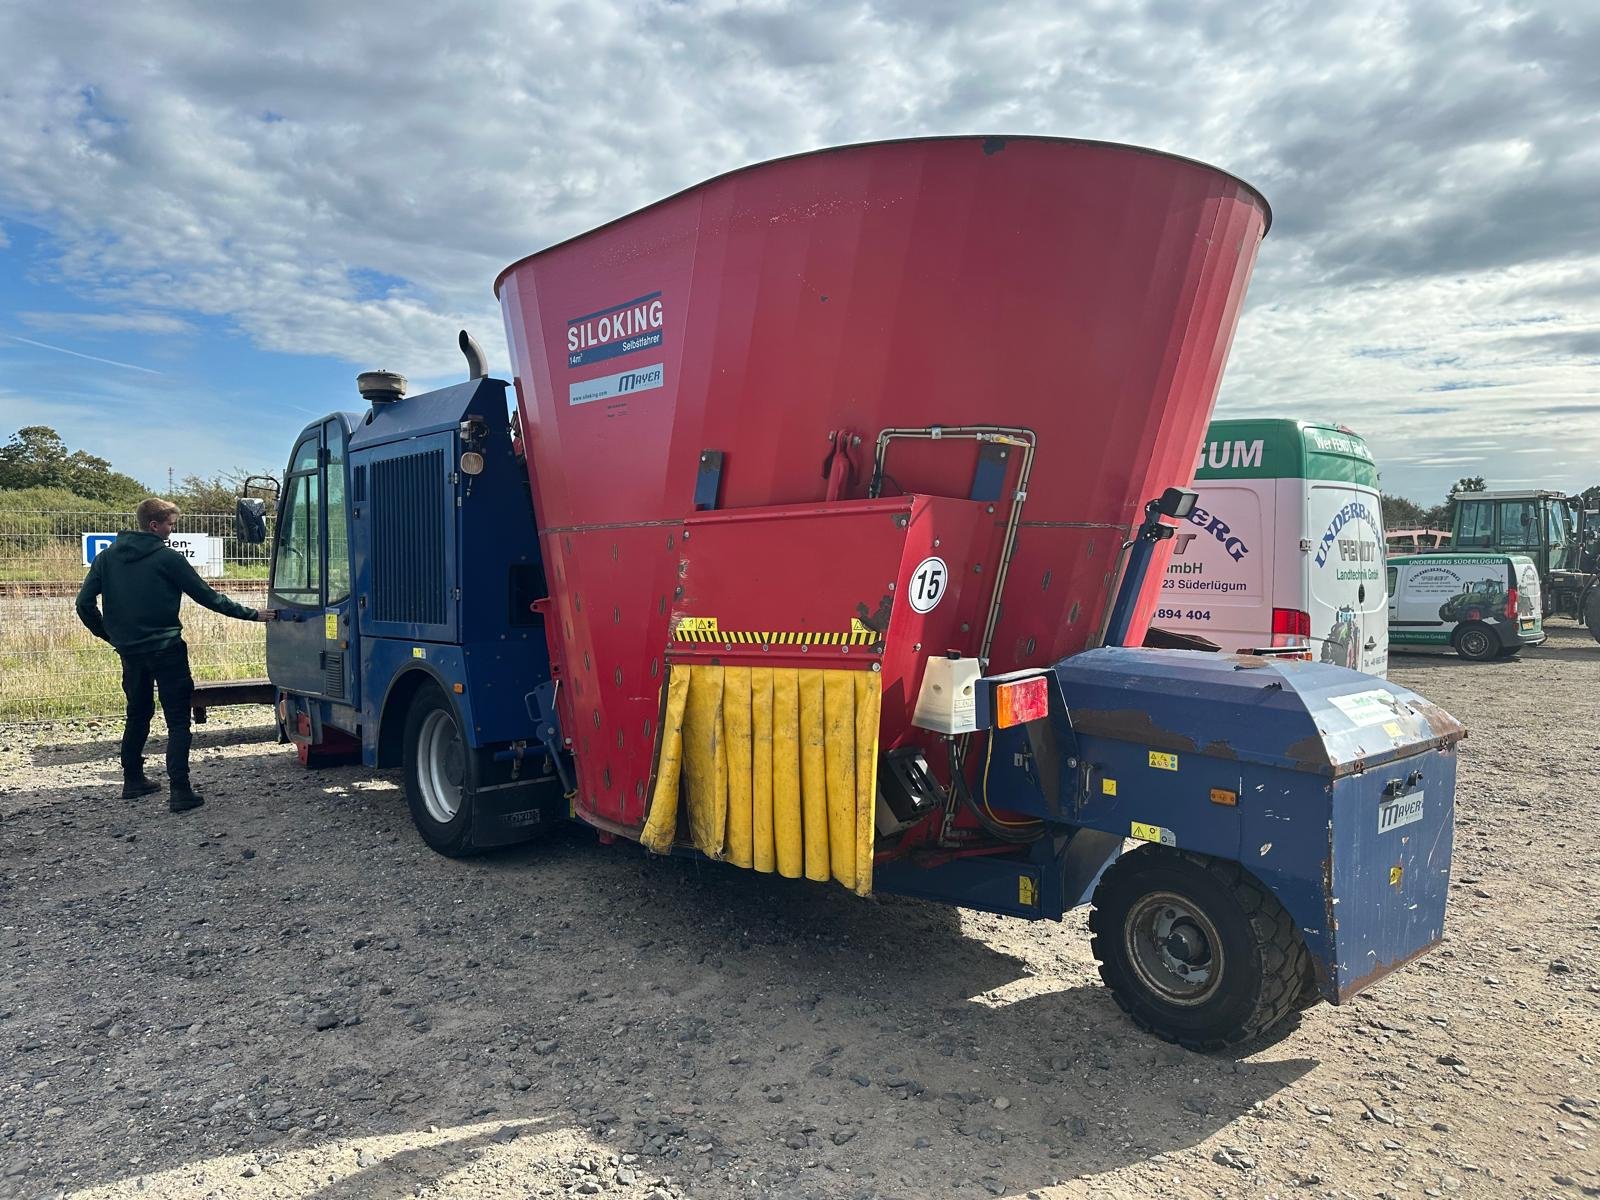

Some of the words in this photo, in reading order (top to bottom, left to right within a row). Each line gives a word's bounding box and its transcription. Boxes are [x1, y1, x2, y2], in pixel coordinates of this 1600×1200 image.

[567, 300, 662, 351] SILOKING
[622, 334, 660, 351] Selbstfahrer
[618, 370, 661, 392] MAYER
[95, 539, 113, 556] P
[917, 570, 942, 600] 15
[1162, 580, 1175, 589] 23
[1178, 579, 1247, 593] Süderlügum
[1186, 610, 1211, 621] 404
[1382, 800, 1421, 828] MAYER
